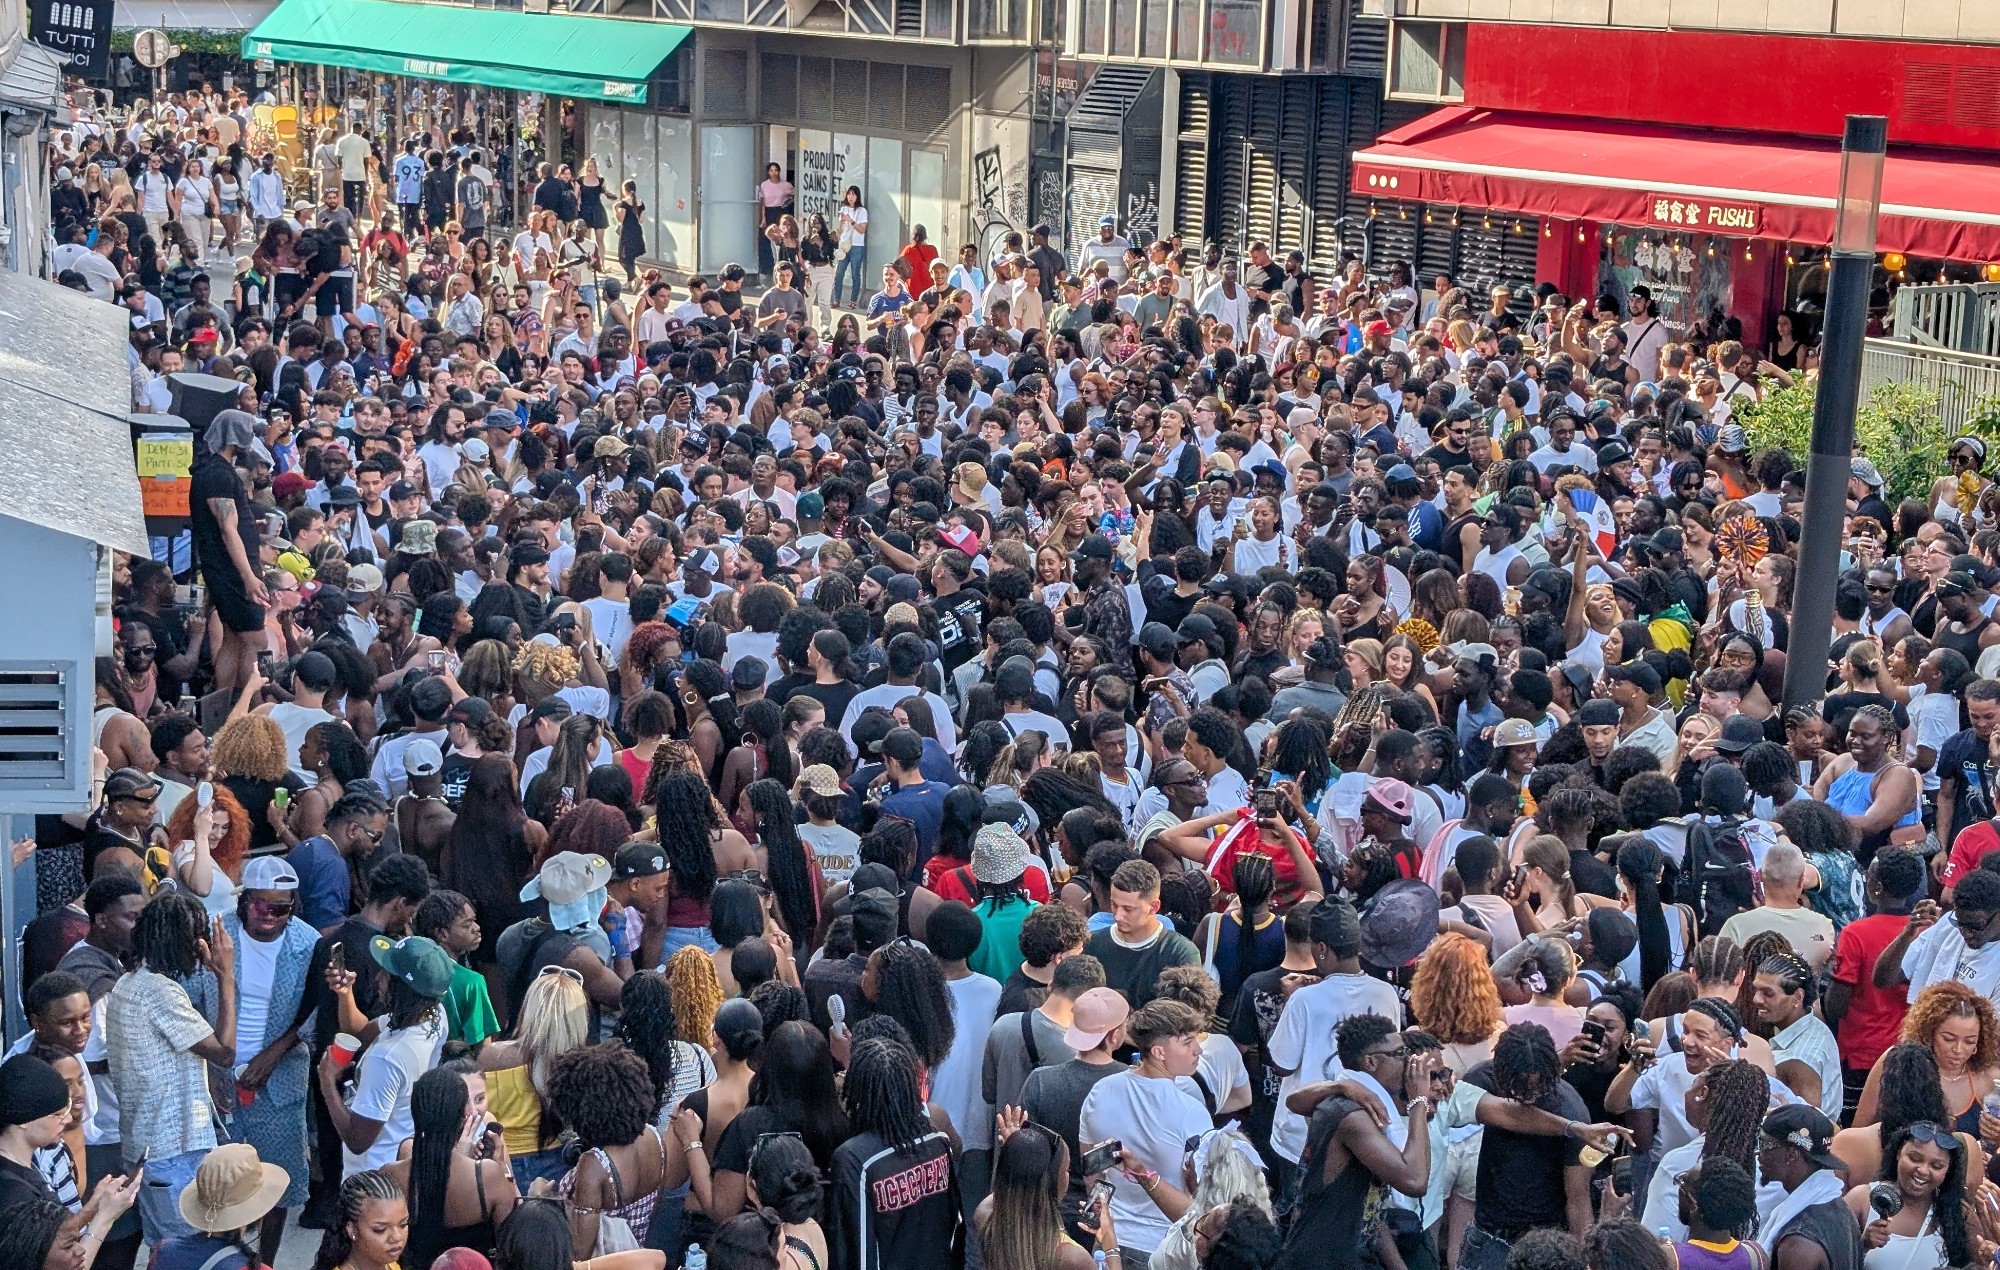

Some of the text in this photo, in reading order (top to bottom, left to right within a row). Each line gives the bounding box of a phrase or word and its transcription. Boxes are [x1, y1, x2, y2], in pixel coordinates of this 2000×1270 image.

[803, 150, 845, 172] PRODUITS
[402, 165, 421, 182] 93
[832, 177, 842, 195] ET
[1707, 206, 1755, 228] FUSHI
